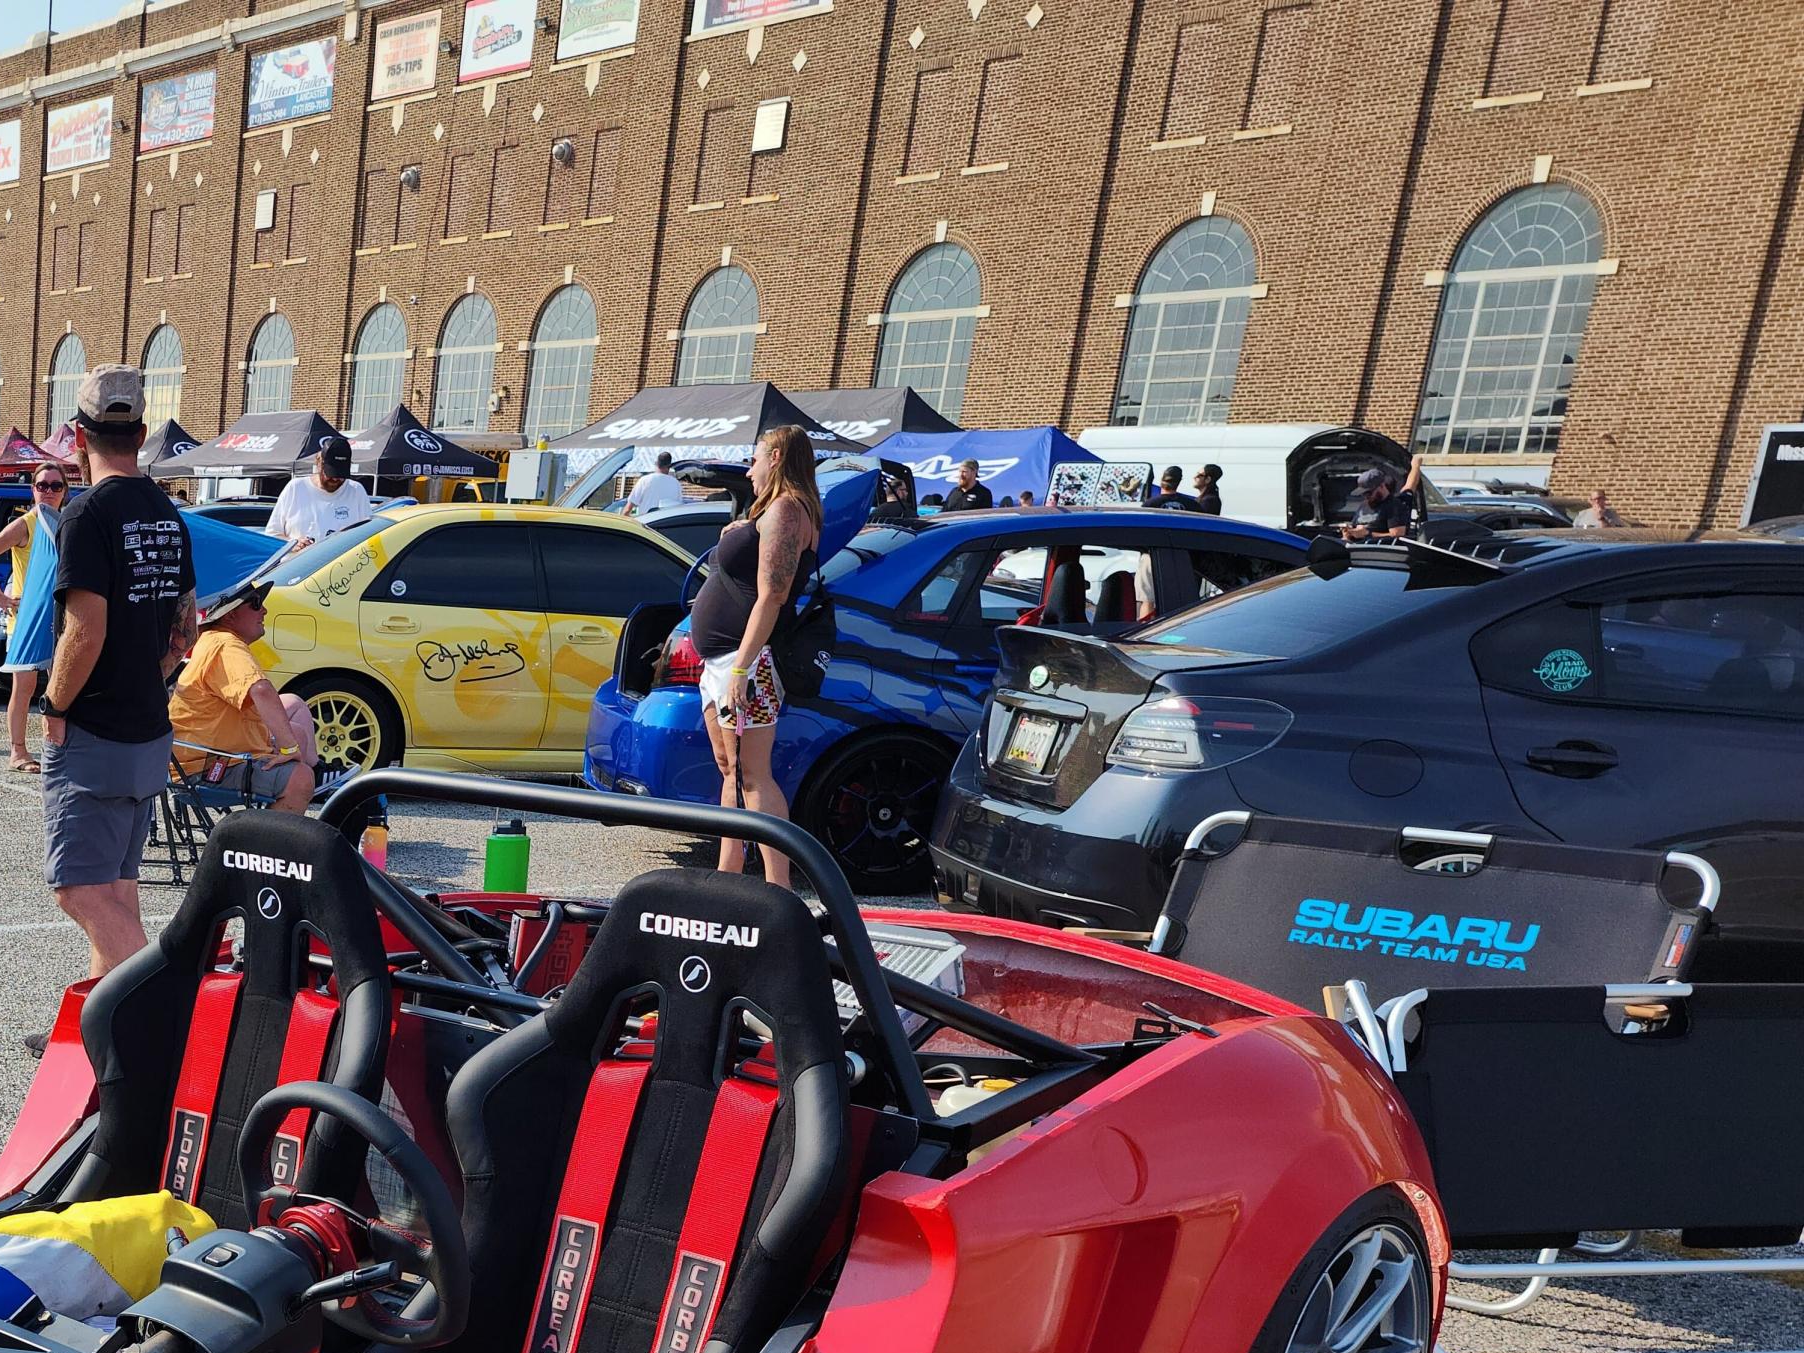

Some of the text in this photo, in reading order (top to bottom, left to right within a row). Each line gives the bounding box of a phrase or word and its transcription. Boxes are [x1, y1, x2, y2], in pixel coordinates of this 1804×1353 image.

[386, 59, 423, 78] 755-TIPS
[149, 124, 206, 148] 717-430-6772
[1553, 682, 1573, 690] CLUB
[222, 849, 313, 882] CORBEAU
[638, 911, 761, 948] CORBEAU
[1294, 897, 1541, 954] SUBARU
[1287, 928, 1527, 972] RALLY TEAM USA
